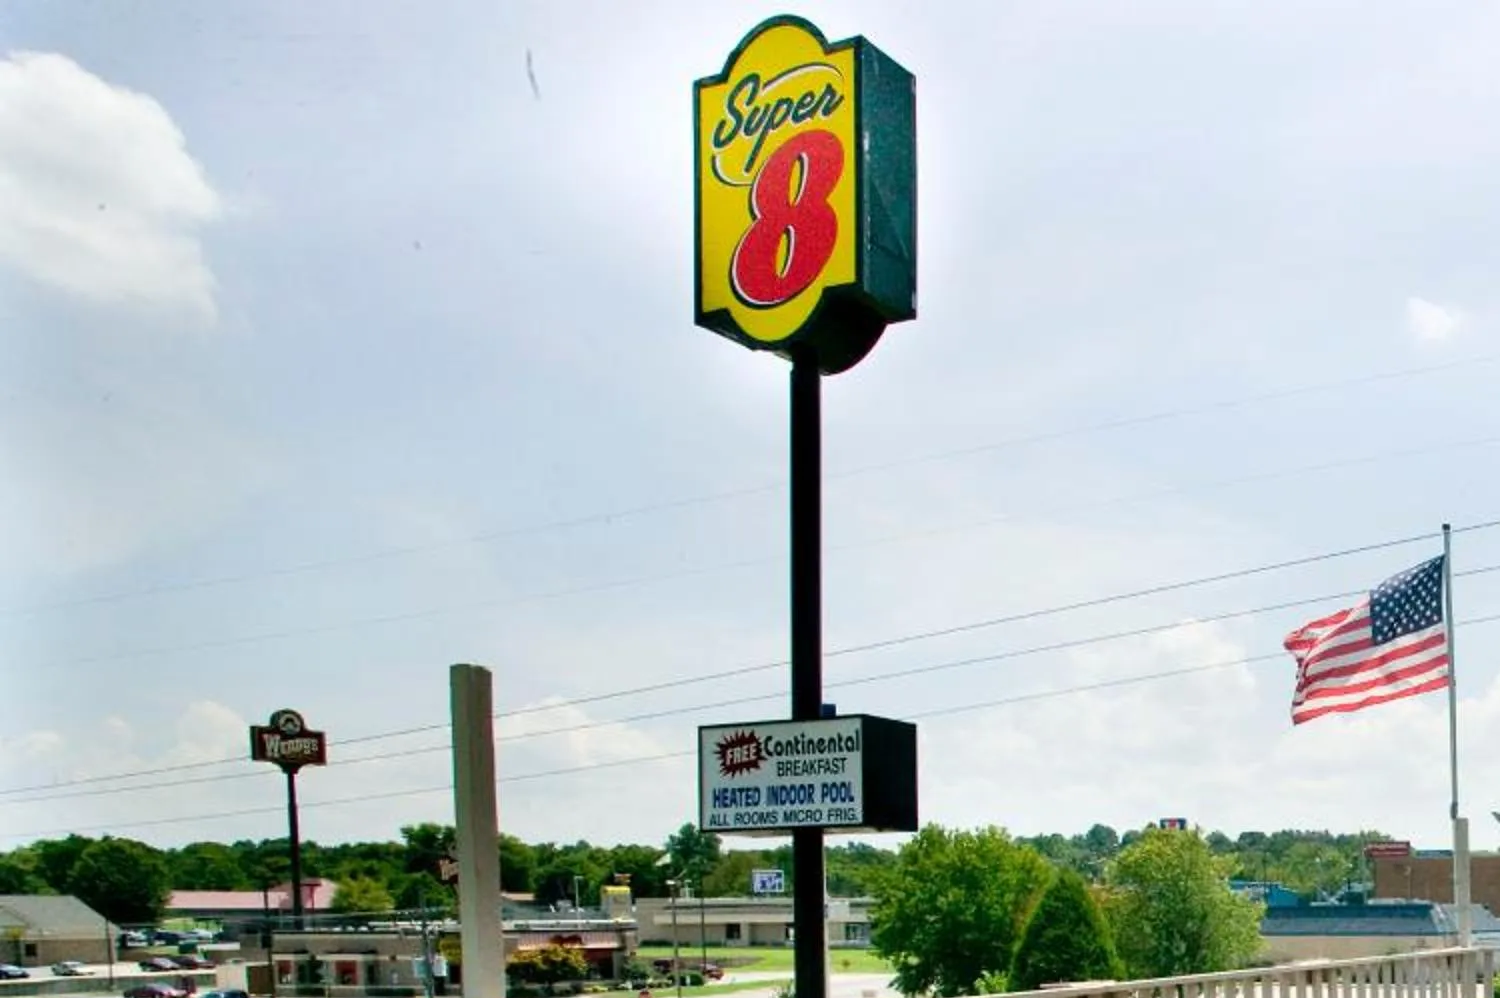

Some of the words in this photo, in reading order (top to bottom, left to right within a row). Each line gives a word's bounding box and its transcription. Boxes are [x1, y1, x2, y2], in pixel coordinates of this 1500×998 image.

[712, 72, 845, 174] Super
[729, 130, 845, 309] 8
[725, 743, 757, 765] FREE
[763, 731, 860, 757] Continental
[777, 757, 848, 777] BREAKFAST
[713, 786, 761, 809] HEATED
[766, 783, 815, 807] INDOOR
[821, 781, 855, 803] POOL
[709, 813, 730, 828] ALL
[734, 810, 779, 825] ROOMS
[783, 808, 823, 824] MICRO
